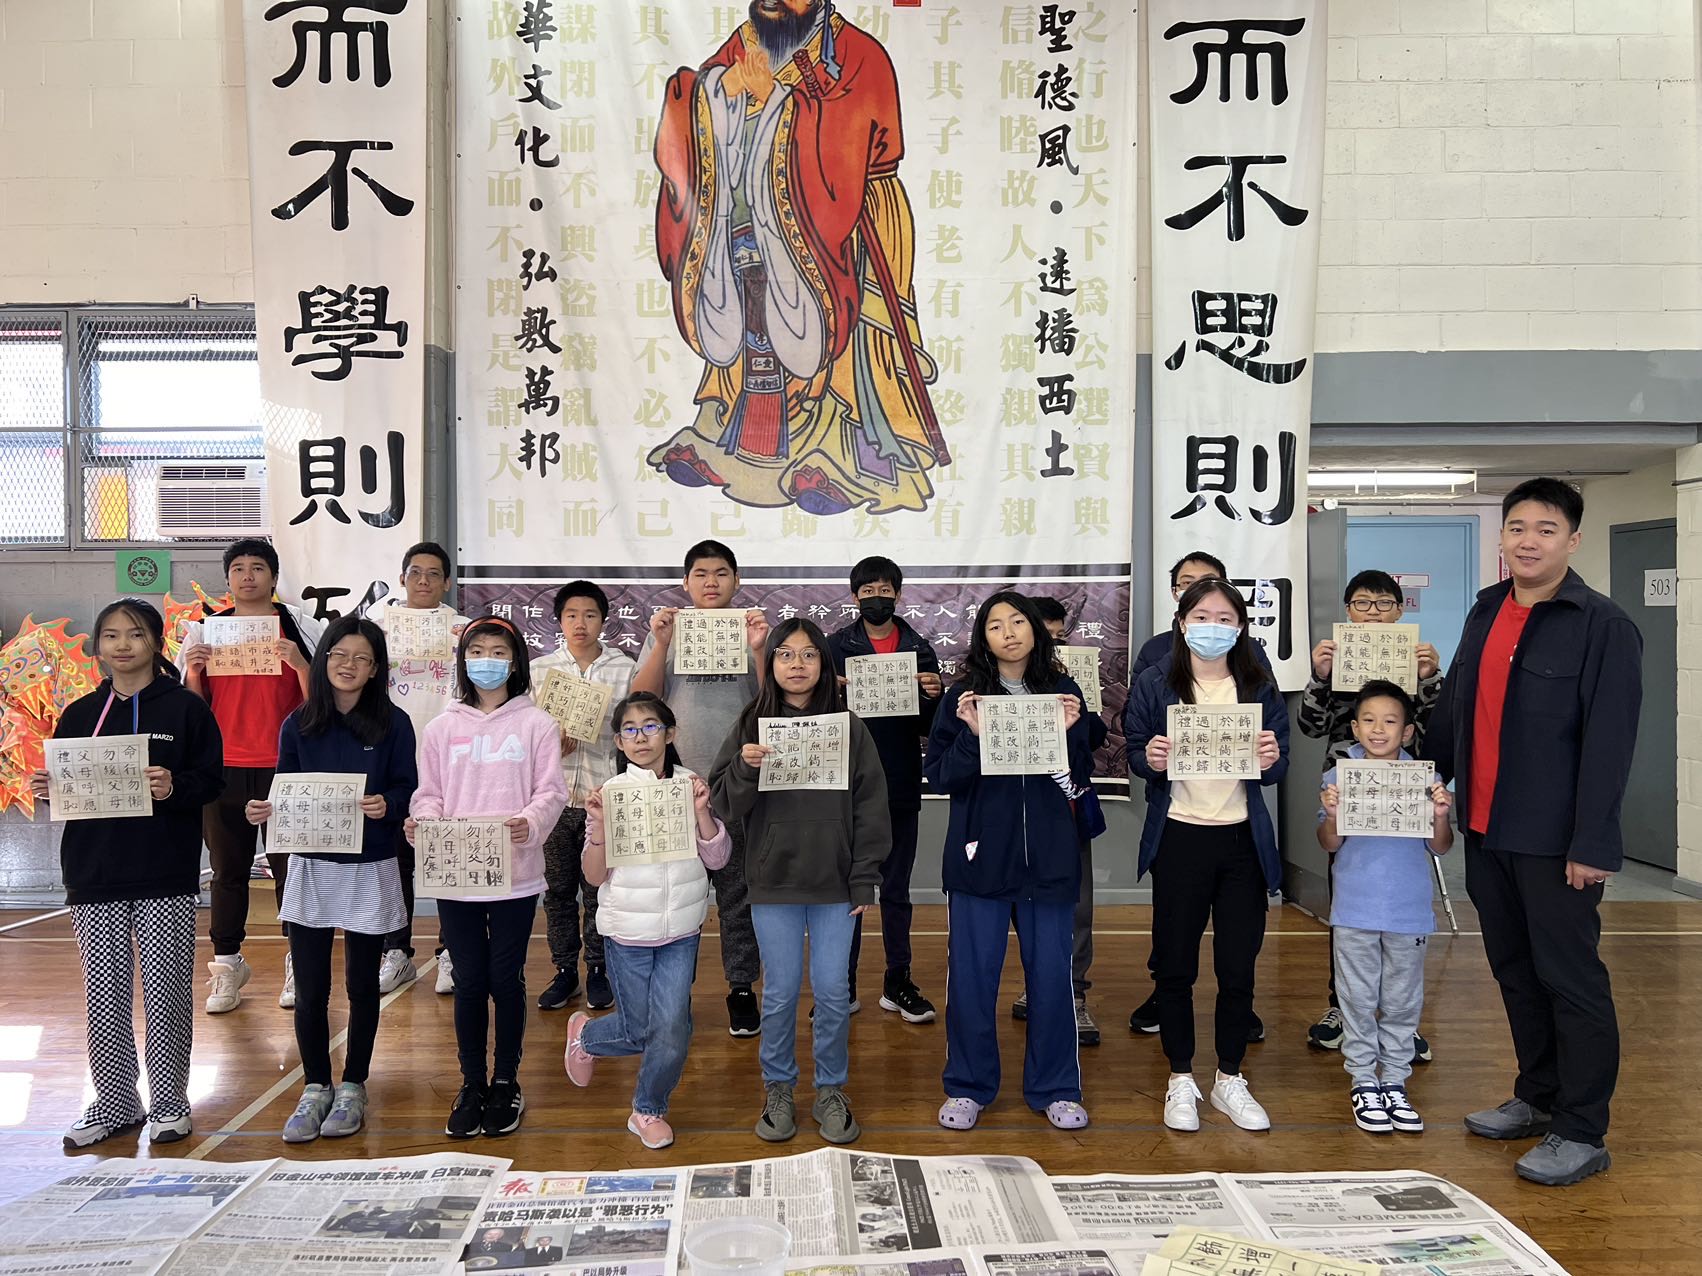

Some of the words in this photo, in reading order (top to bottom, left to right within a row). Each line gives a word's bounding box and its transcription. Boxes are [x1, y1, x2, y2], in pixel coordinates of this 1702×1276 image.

[853, 4, 890, 44] 幼
[1650, 578, 1671, 596] 503
[778, 604, 799, 619] 者
[1075, 621, 1105, 640] 禮
[449, 734, 525, 766] FILA
